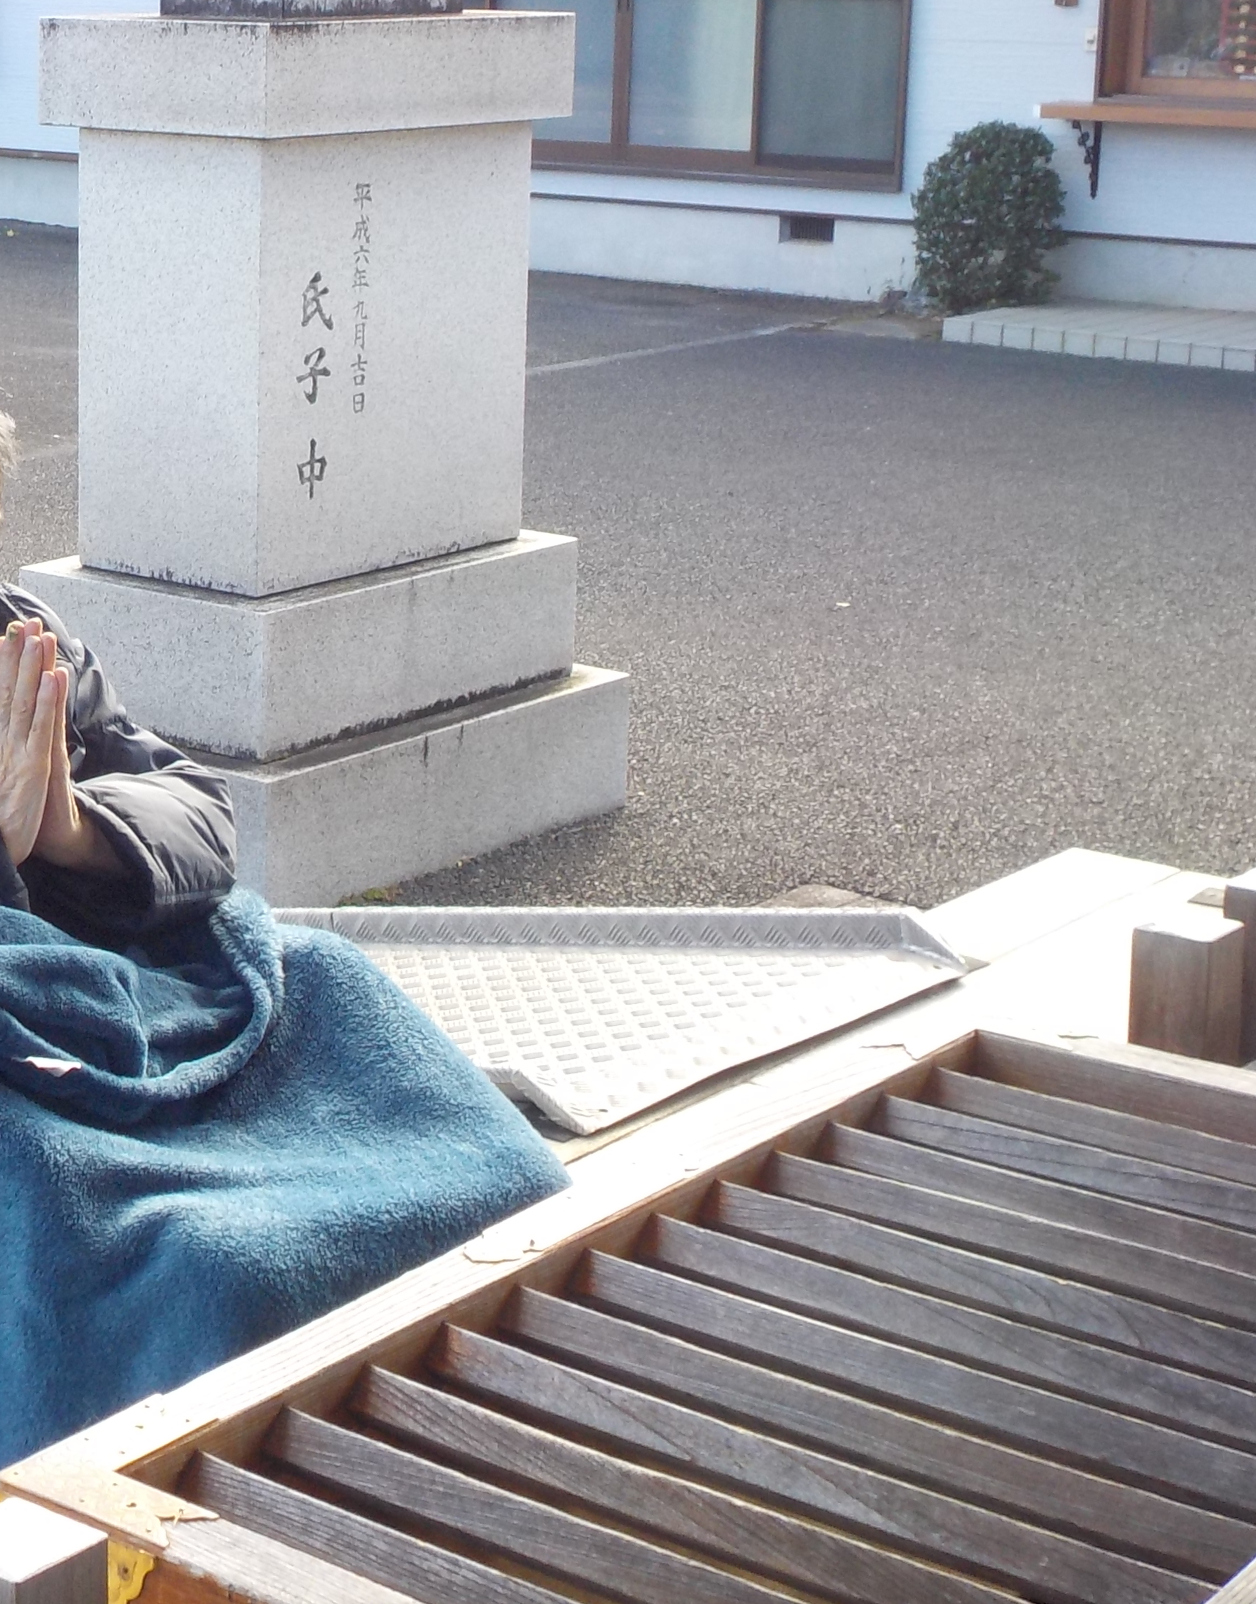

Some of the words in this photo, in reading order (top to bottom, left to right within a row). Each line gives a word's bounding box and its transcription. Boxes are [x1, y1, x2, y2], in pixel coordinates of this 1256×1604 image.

[295, 270, 334, 500] 氏子中
[350, 182, 373, 414] 平成六年九月吉日
